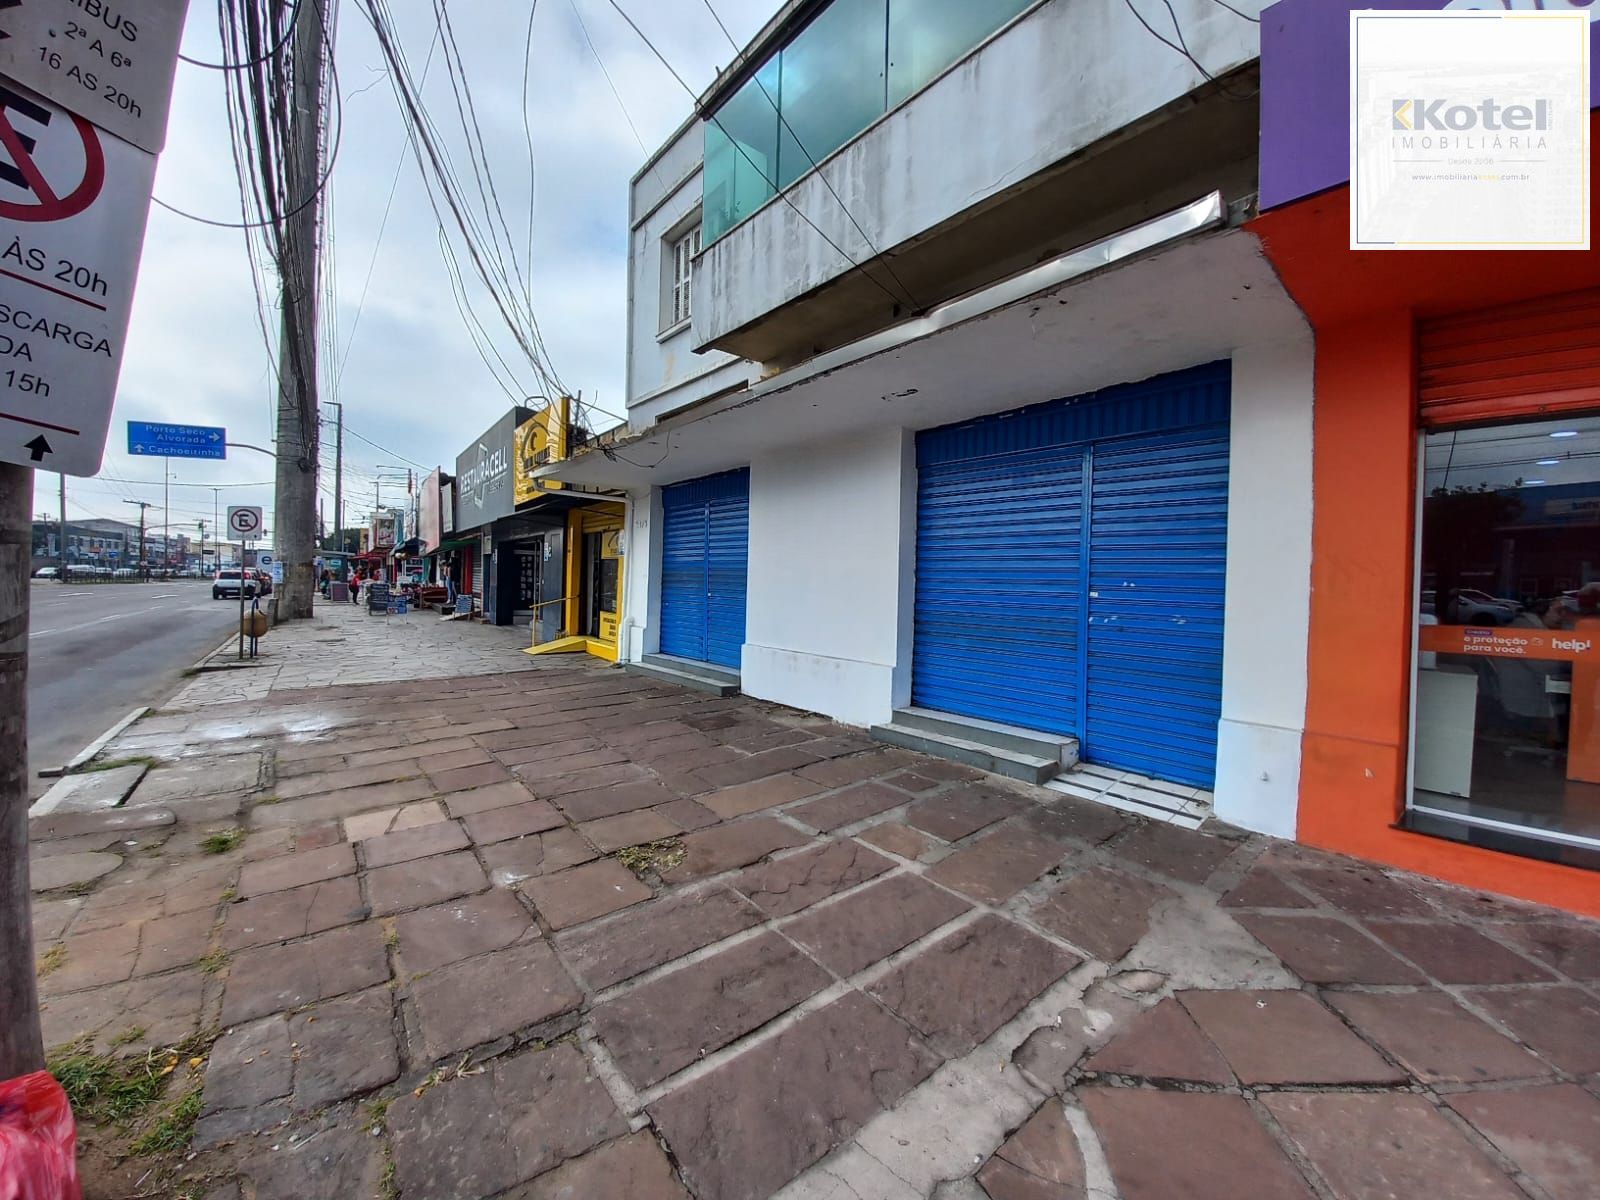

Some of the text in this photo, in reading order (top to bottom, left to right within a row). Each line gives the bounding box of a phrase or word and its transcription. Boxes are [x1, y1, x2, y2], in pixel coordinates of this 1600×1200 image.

[70, 0, 138, 42] BUS
[89, 40, 104, 58] A
[39, 47, 62, 70] 16
[103, 85, 142, 118] 20h
[2, 236, 108, 296] ÀS 20h
[0, 304, 112, 357] SCARGA
[5, 369, 51, 398] 15h
[145, 424, 206, 436] Porto Seco
[156, 433, 206, 444] Alvorada
[1463, 644, 1492, 653] para
[1473, 636, 1528, 647] proteção
[1551, 637, 1591, 653] help!
